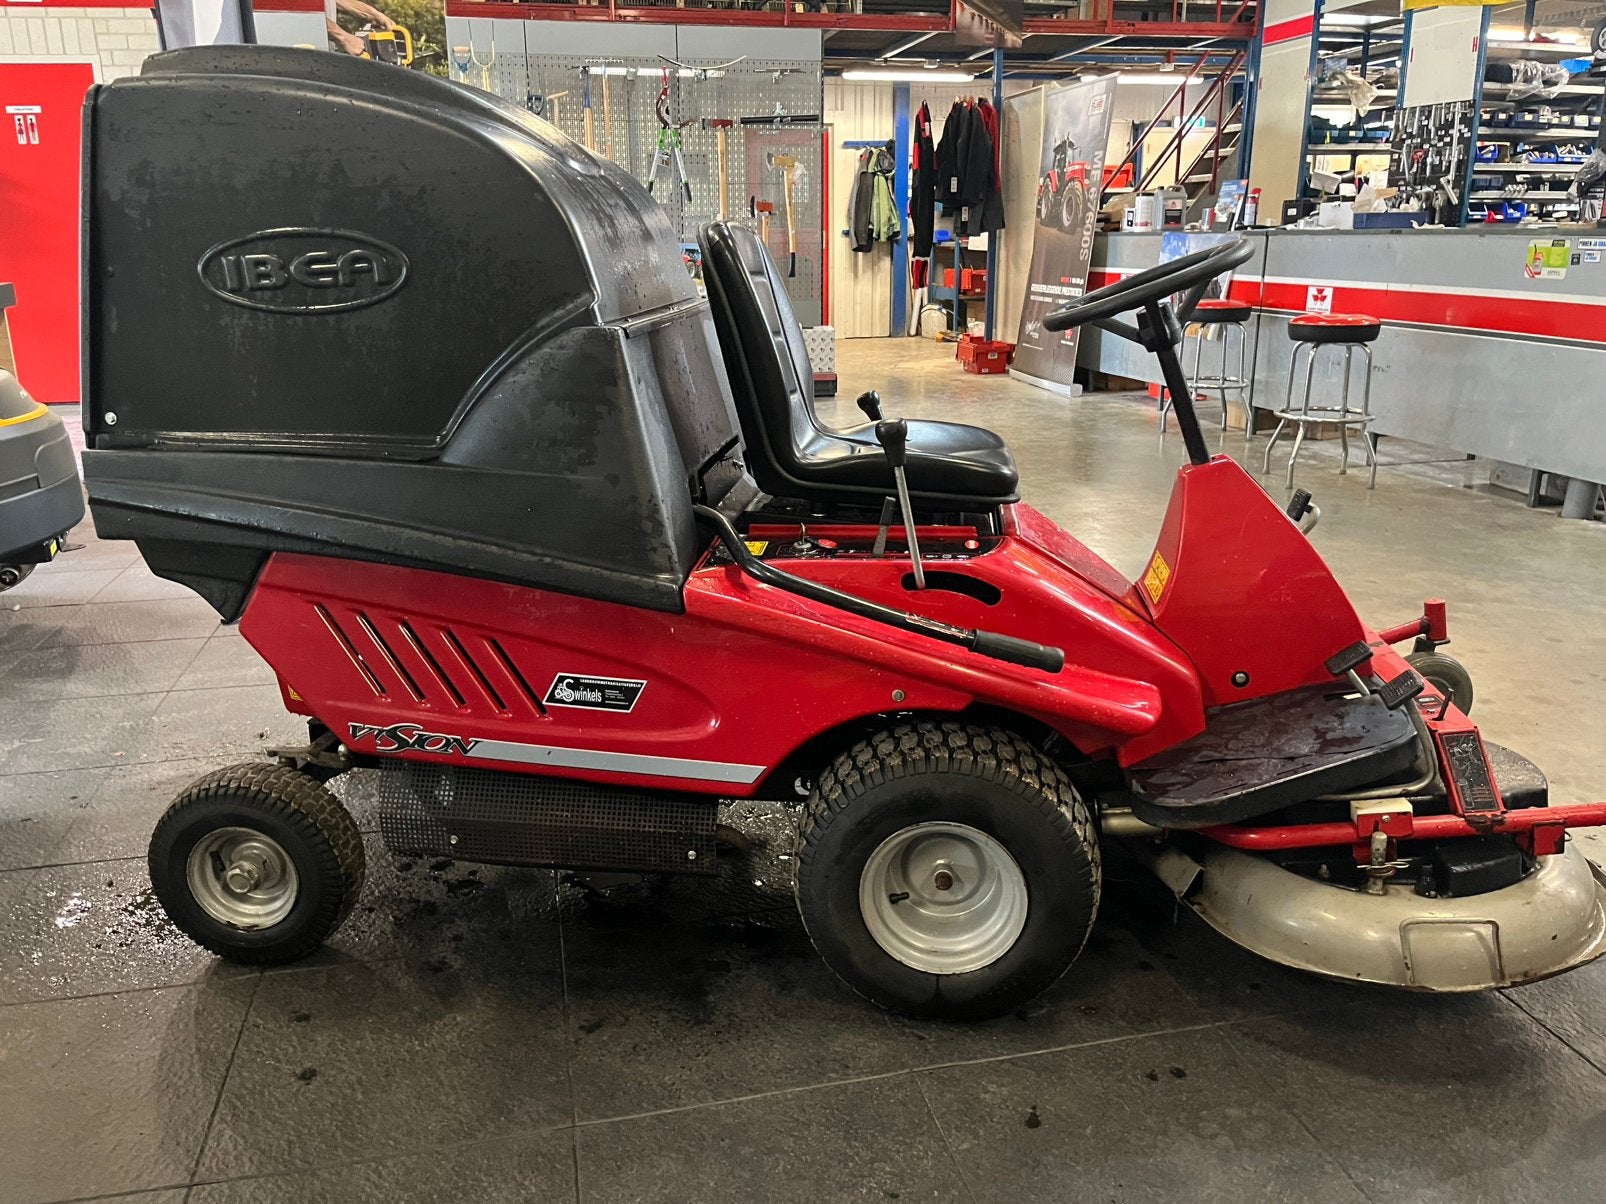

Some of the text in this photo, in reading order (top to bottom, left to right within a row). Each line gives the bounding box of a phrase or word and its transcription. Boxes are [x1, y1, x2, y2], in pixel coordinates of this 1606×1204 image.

[1091, 150, 1104, 183] MF
[220, 249, 389, 289] IBEA
[562, 678, 602, 702] Swinkels
[347, 721, 481, 755] VISION
